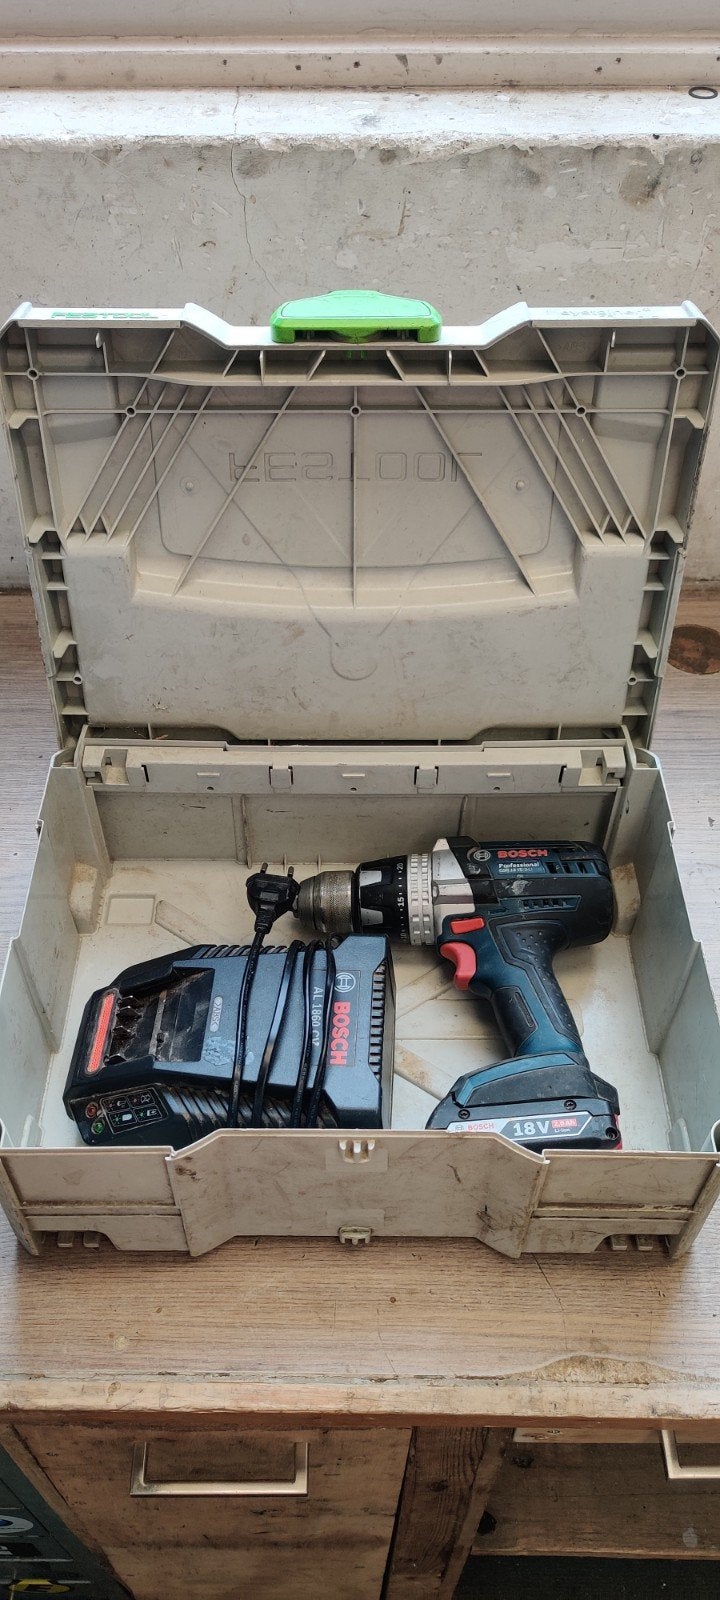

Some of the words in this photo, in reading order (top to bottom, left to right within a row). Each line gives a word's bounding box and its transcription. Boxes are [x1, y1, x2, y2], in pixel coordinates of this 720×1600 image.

[497, 849, 548, 859] BOSCH
[498, 861, 540, 869] Professional
[397, 896, 405, 907] 15
[313, 986, 324, 1001] AL
[311, 1003, 322, 1027] 1860
[329, 1001, 351, 1065] BOSCH
[466, 1122, 495, 1131] BOSCH
[512, 1120, 550, 1137] 18V
